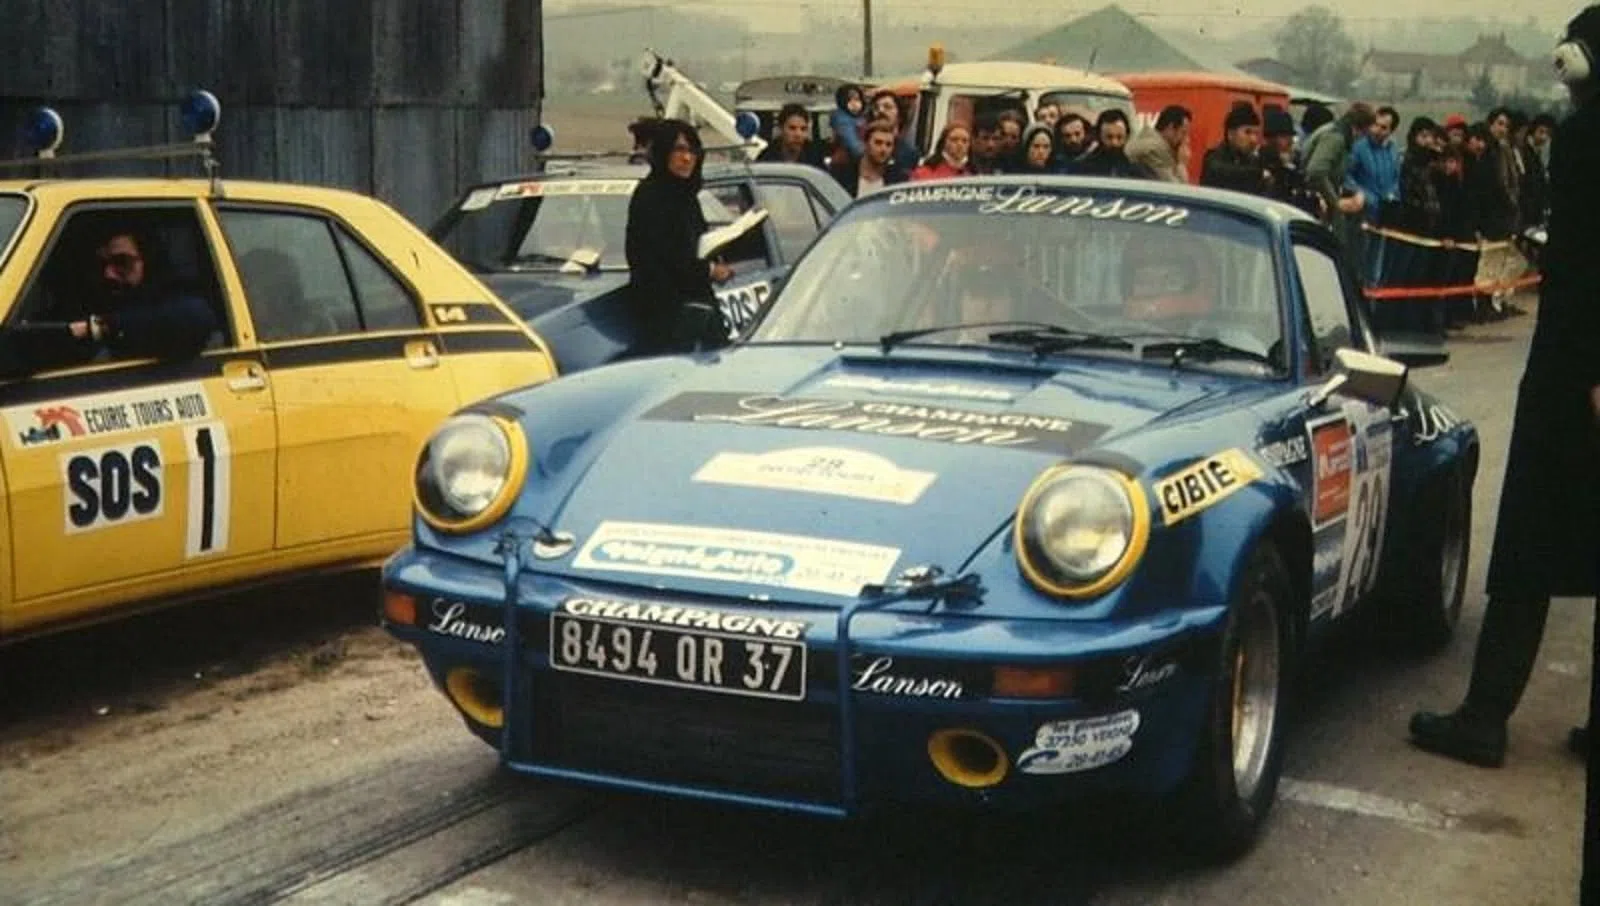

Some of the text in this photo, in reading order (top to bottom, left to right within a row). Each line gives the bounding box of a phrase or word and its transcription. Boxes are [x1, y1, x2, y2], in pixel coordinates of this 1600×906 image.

[889, 184, 1189, 227] CHAMPAGNE Lanson
[84, 393, 207, 434] ECURIE TOURS AUTO
[862, 402, 1074, 433] CHAMPAGNE
[67, 444, 161, 528] SOS
[194, 426, 216, 552] 1
[1162, 460, 1237, 515] CIBIE
[427, 597, 506, 643] Lanso
[564, 598, 804, 640] CHAMPAGNE
[562, 619, 793, 691] 8494 QR 37
[850, 654, 963, 699] Lanson
